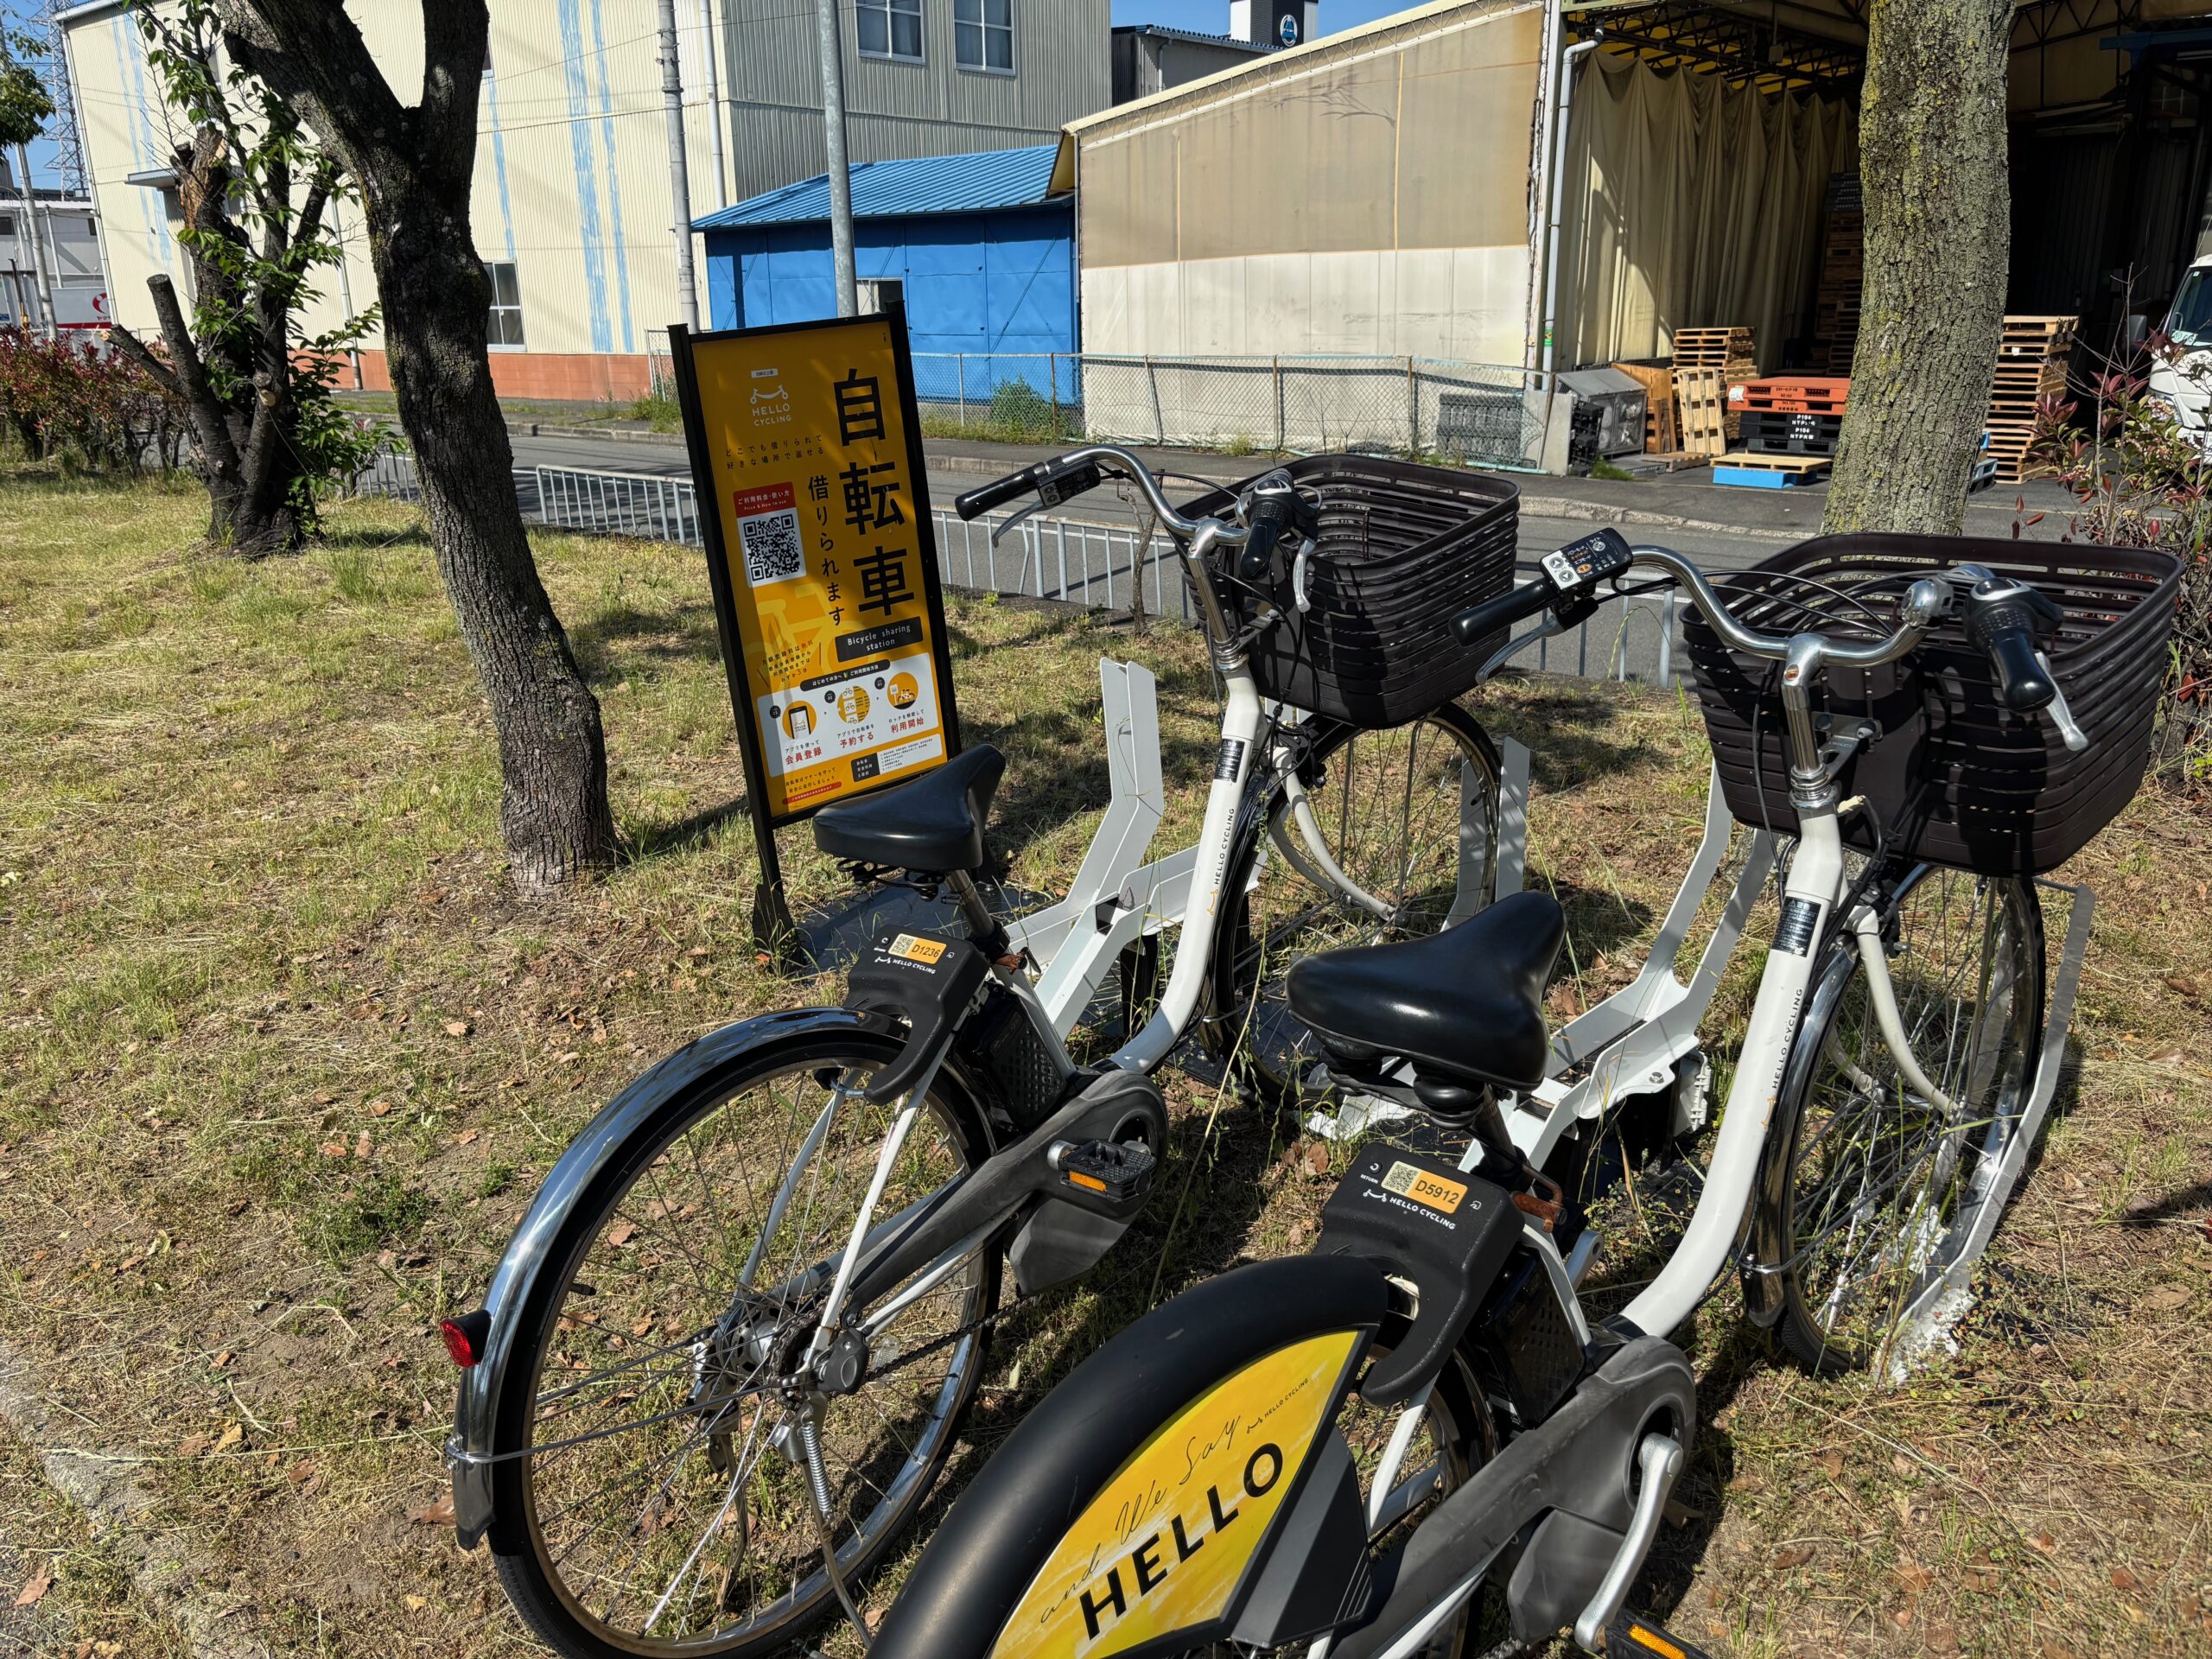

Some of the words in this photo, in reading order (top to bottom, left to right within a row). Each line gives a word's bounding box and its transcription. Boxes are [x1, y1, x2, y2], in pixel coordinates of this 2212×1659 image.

[752, 403, 790, 416] HELLO
[753, 415, 791, 427] CYCLING
[726, 435, 822, 457] どこでも借りられて
[727, 448, 823, 469] 好きな場所で返せる
[834, 368, 914, 616] 自転車
[809, 475, 845, 626] 借りられます
[848, 631, 877, 646] Bicycle
[881, 624, 911, 639] sharing
[866, 638, 895, 652] station
[837, 723, 874, 739] アプリで自転車を
[891, 717, 925, 734] 利用開始
[839, 732, 874, 748] 予約する
[785, 747, 823, 766] 会員登録
[1214, 853, 1226, 885] HELLO
[1221, 808, 1236, 849] CYCLING
[911, 944, 941, 958] D1236
[893, 958, 912, 967] HELLO
[912, 963, 936, 975] CYCLING
[1771, 1047, 1788, 1089] HELLO
[1783, 988, 1802, 1043] CYCLING
[1414, 1179, 1459, 1205] D5912
[1389, 1197, 1419, 1212] HELLO
[1420, 1208, 1456, 1230] CYCLING
[1264, 1399, 1284, 1418] HELLO
[1284, 1377, 1308, 1401] CYCLING
[1040, 1542, 1101, 1624] and
[1115, 1479, 1167, 1547] We
[1179, 1414, 1242, 1485] Say
[1079, 1443, 1284, 1641] HELLO
